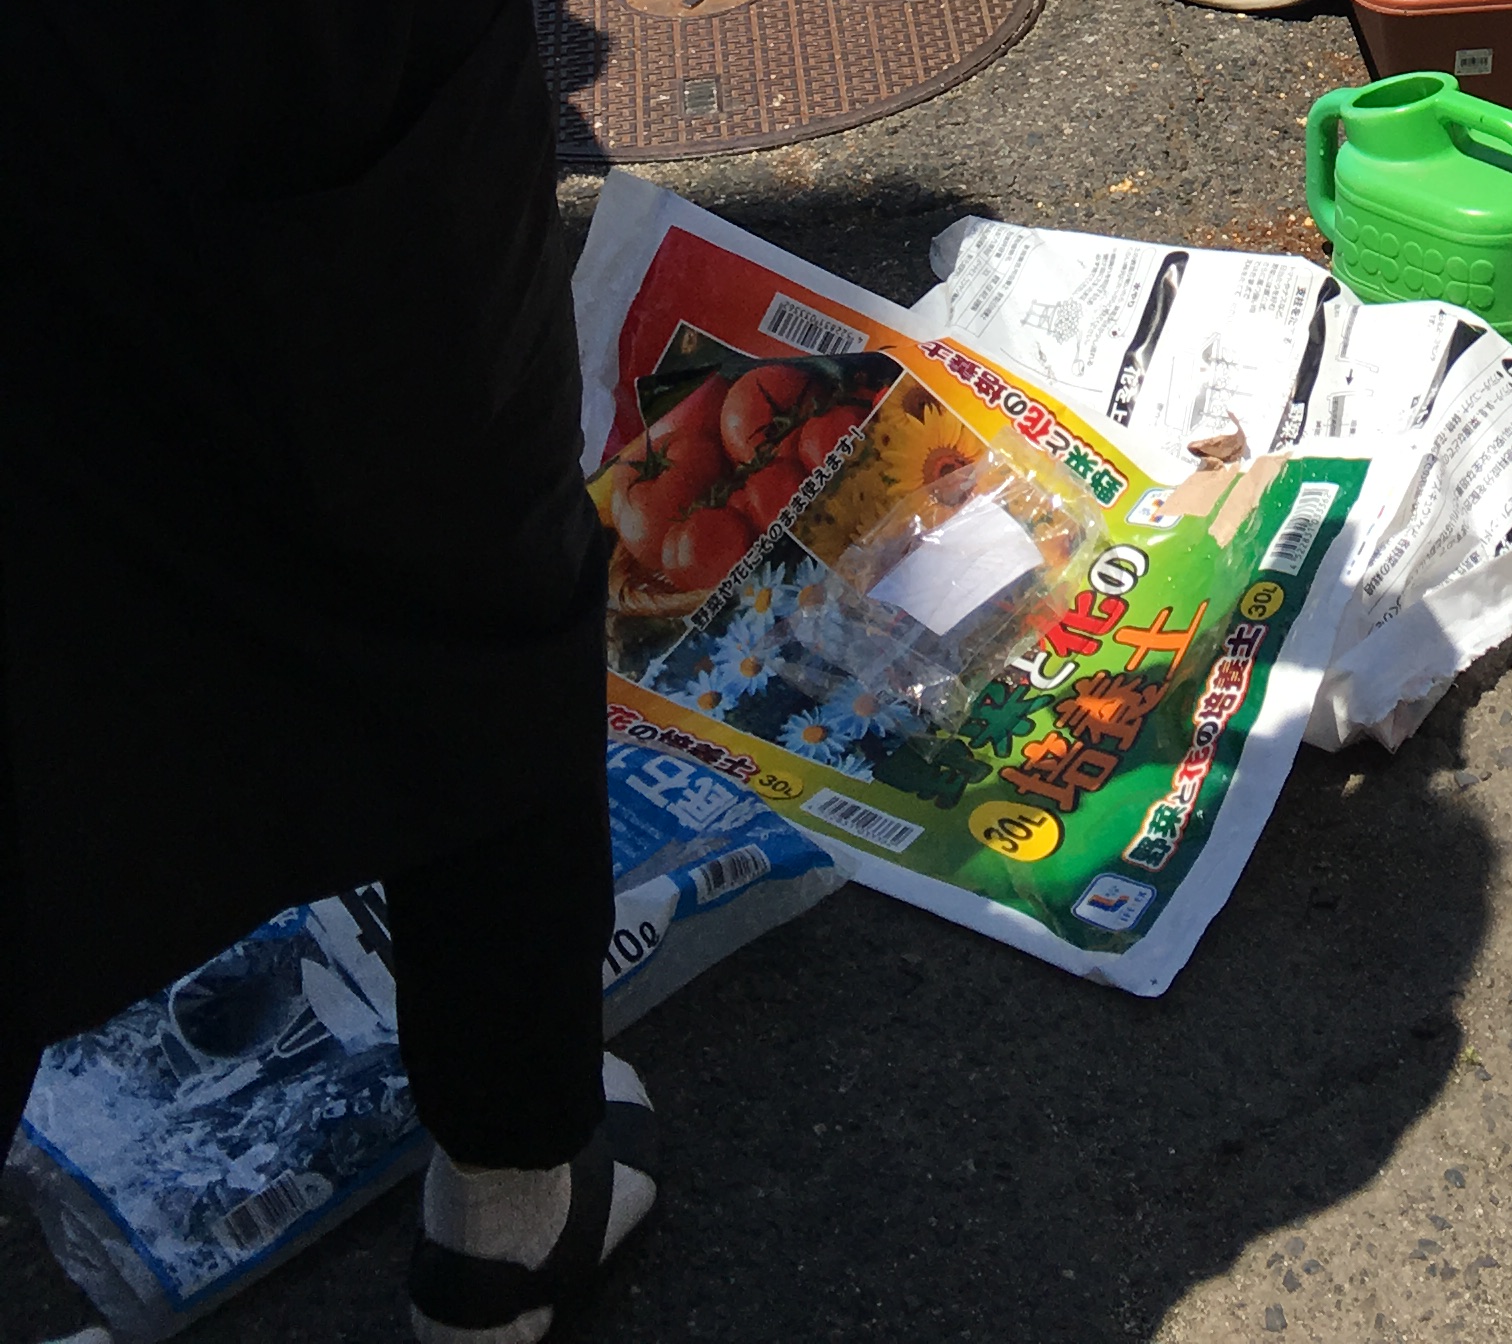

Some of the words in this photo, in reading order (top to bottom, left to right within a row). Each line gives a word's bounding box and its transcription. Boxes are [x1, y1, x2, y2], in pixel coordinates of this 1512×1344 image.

[921, 341, 1128, 507] 野菜と花の培養土
[1248, 583, 1280, 617] 30L
[999, 598, 1210, 813] 培養土
[1128, 624, 1266, 867] 野菜と花の培養土
[758, 774, 793, 797] 30L
[983, 812, 1047, 854] 30L
